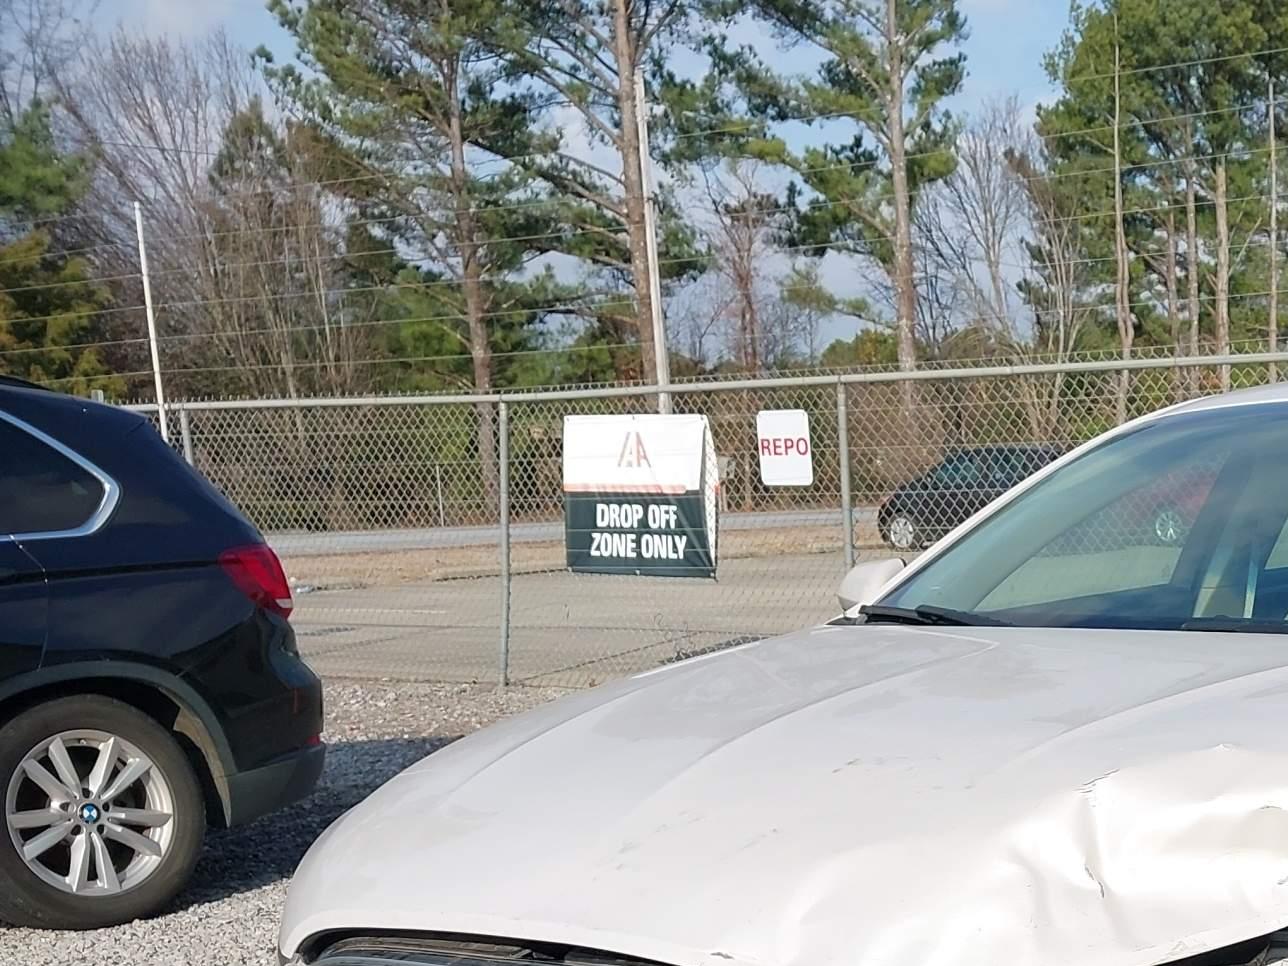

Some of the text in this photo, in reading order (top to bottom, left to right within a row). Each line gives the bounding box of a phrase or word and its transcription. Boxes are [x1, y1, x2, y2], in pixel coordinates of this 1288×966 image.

[760, 437, 809, 456] REPO
[595, 503, 678, 529] DROP OFF
[590, 532, 687, 560] ZONE ONLY
